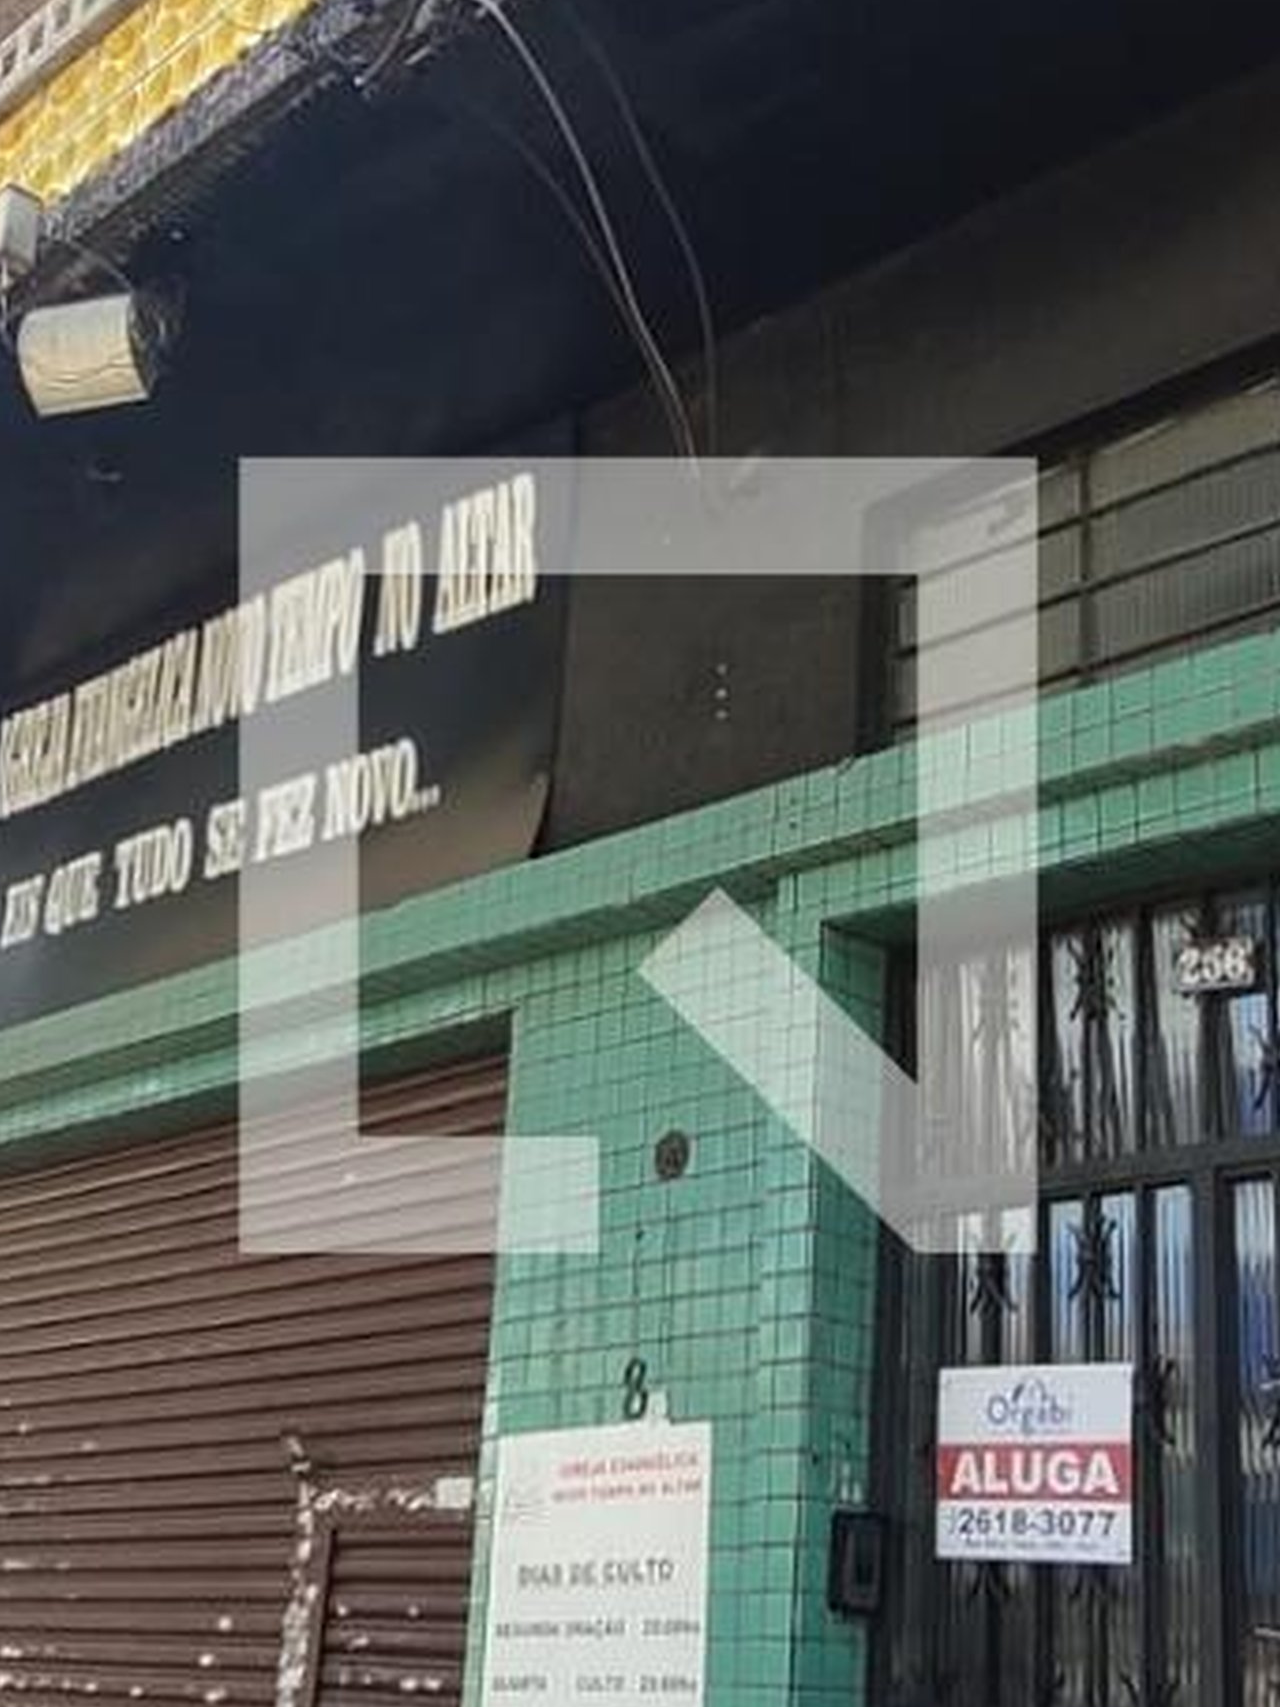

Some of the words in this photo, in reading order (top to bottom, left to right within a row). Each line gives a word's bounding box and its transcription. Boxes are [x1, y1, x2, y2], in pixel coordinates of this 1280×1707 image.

[431, 472, 538, 634] ALTAR
[113, 816, 193, 910] TUDO
[201, 798, 246, 881] SE
[253, 772, 317, 864] FEZ
[950, 1450, 1120, 1495] ALUGA
[958, 1506, 1118, 1537] 2618-3077
[602, 1557, 676, 1587] CULTO
